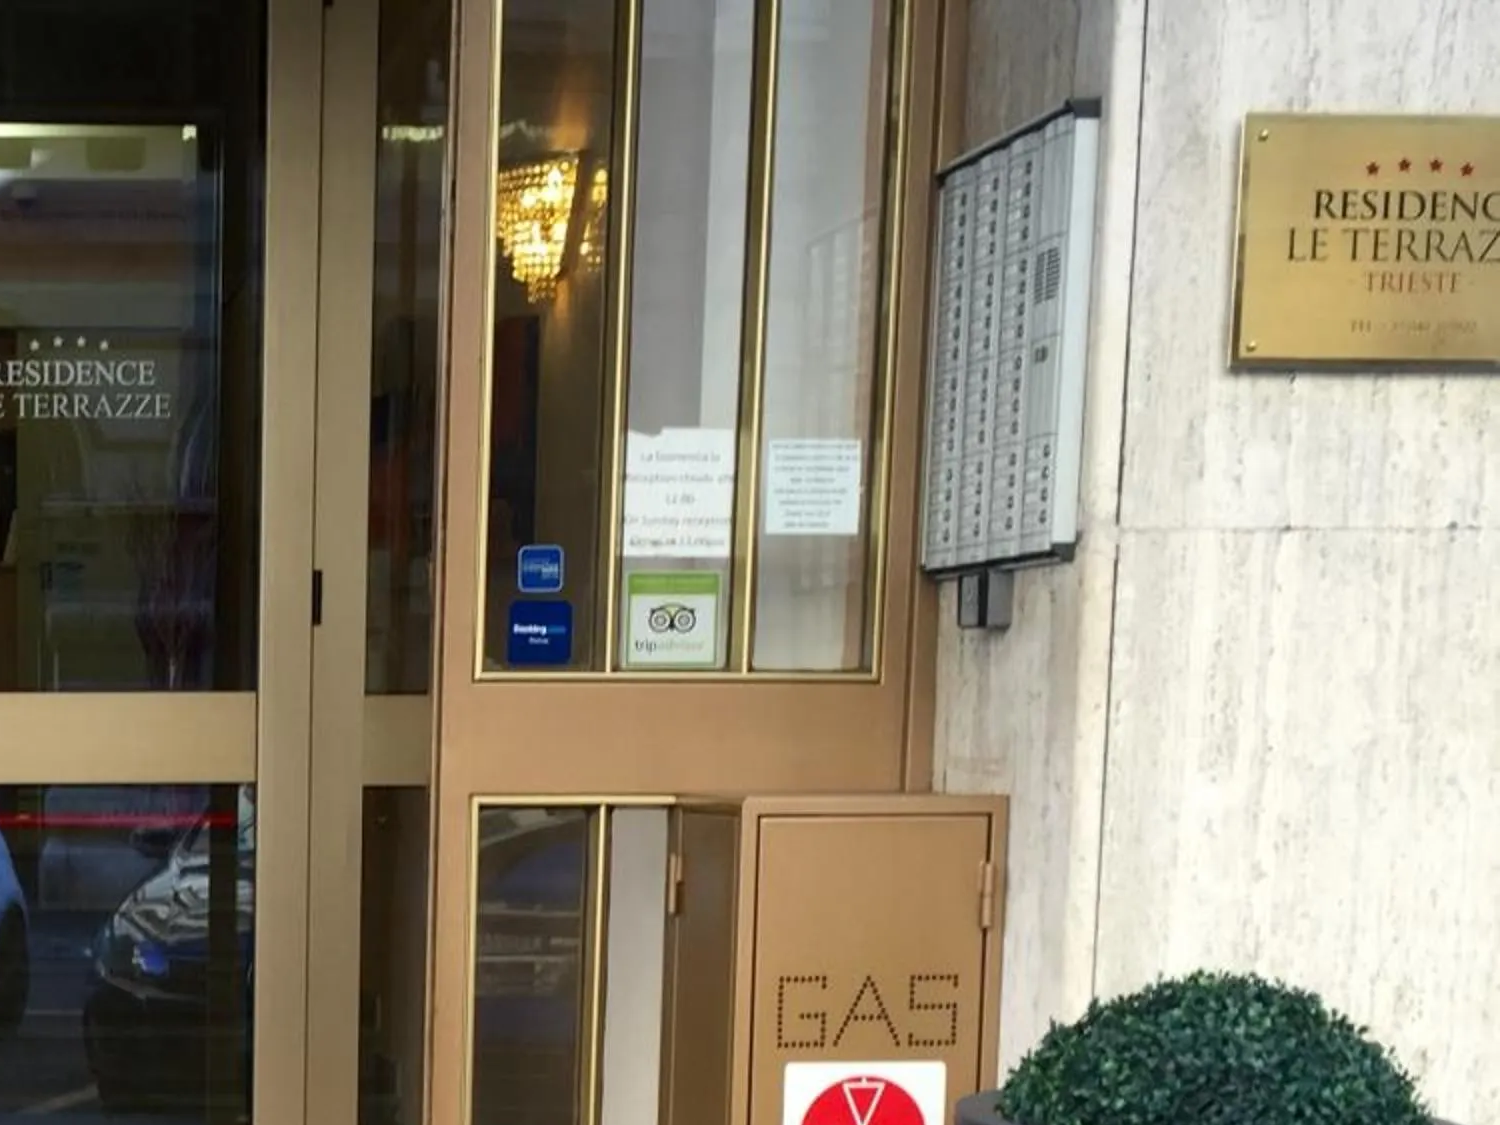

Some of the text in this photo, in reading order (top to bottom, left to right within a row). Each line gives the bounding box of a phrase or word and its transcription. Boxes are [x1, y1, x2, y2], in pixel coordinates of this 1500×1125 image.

[1287, 227, 1328, 263] LE
[1364, 269, 1462, 294] TRIESTE
[12, 393, 171, 420] TERRAZZE
[513, 623, 566, 636] Booking
[776, 974, 959, 1049] GAS
